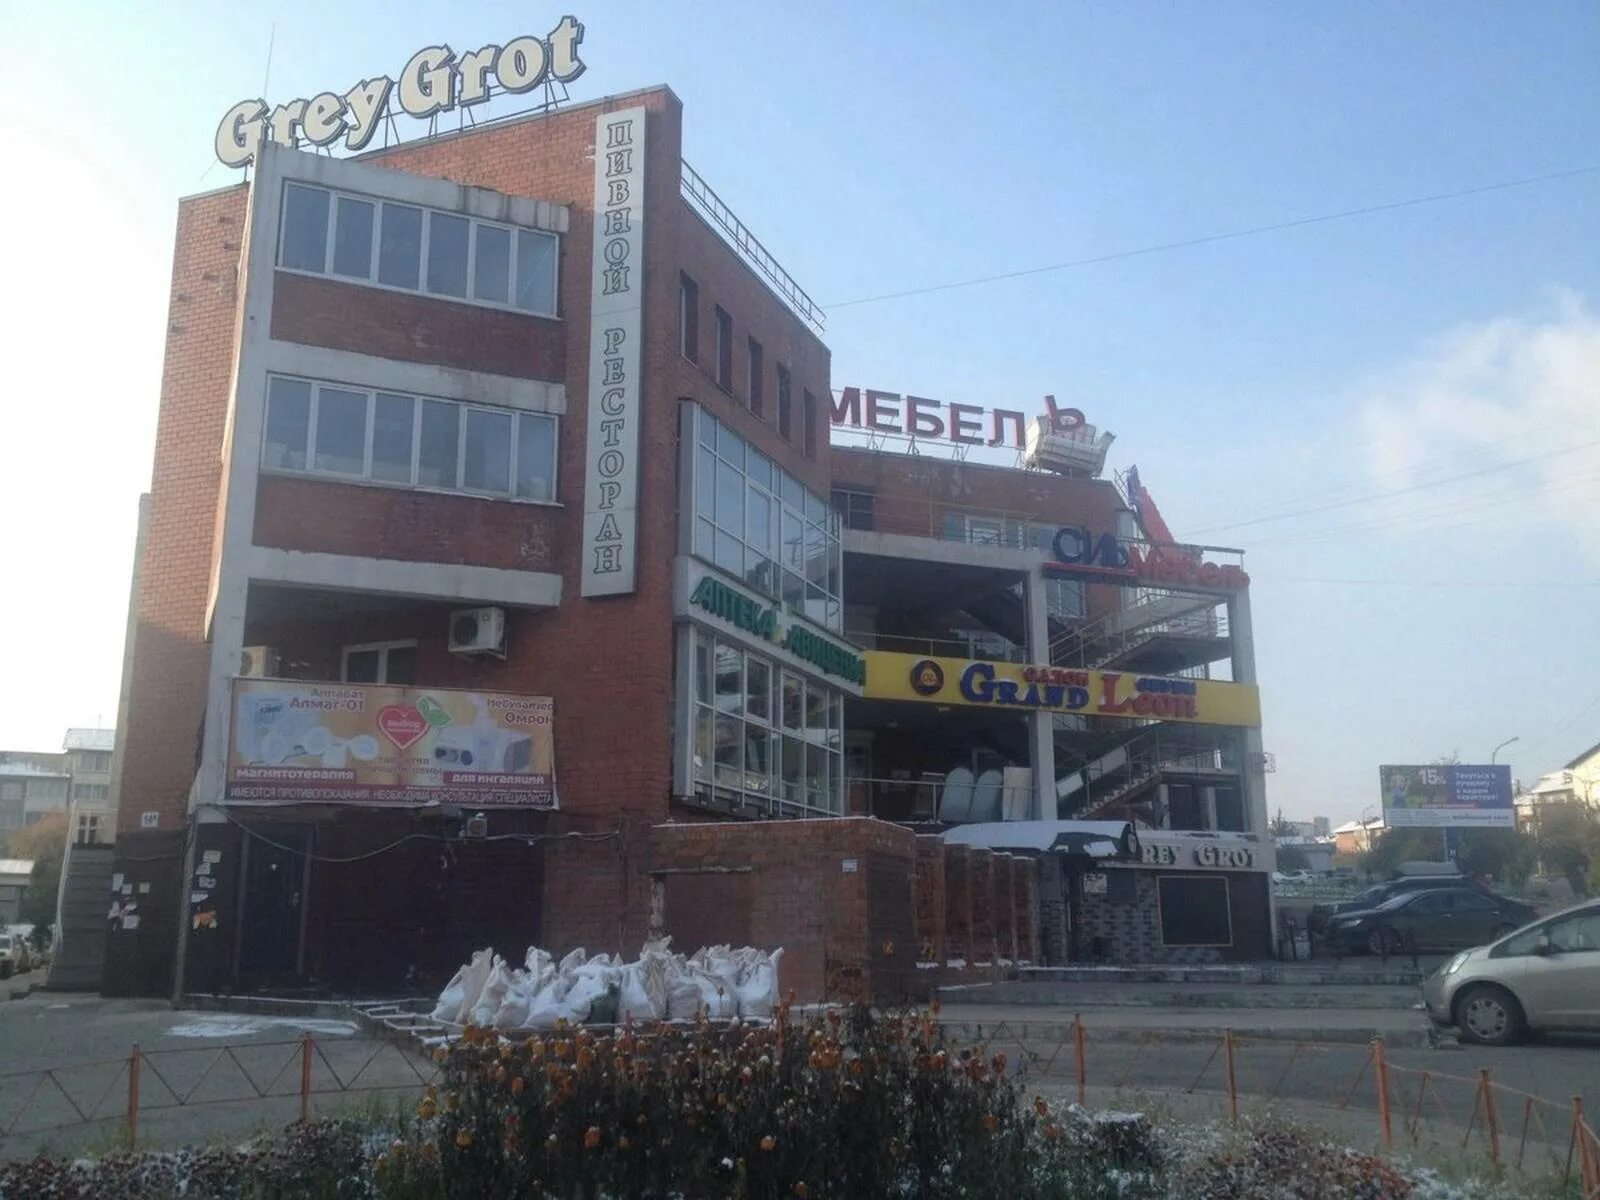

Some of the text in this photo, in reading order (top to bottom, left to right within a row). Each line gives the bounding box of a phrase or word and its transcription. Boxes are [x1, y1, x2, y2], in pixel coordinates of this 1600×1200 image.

[215, 16, 587, 168] Grey Grot
[601, 119, 633, 295] ПИВНОЙ
[593, 327, 626, 574] РЕСТОРАН
[828, 385, 1086, 450] МЕБЕЛЬ
